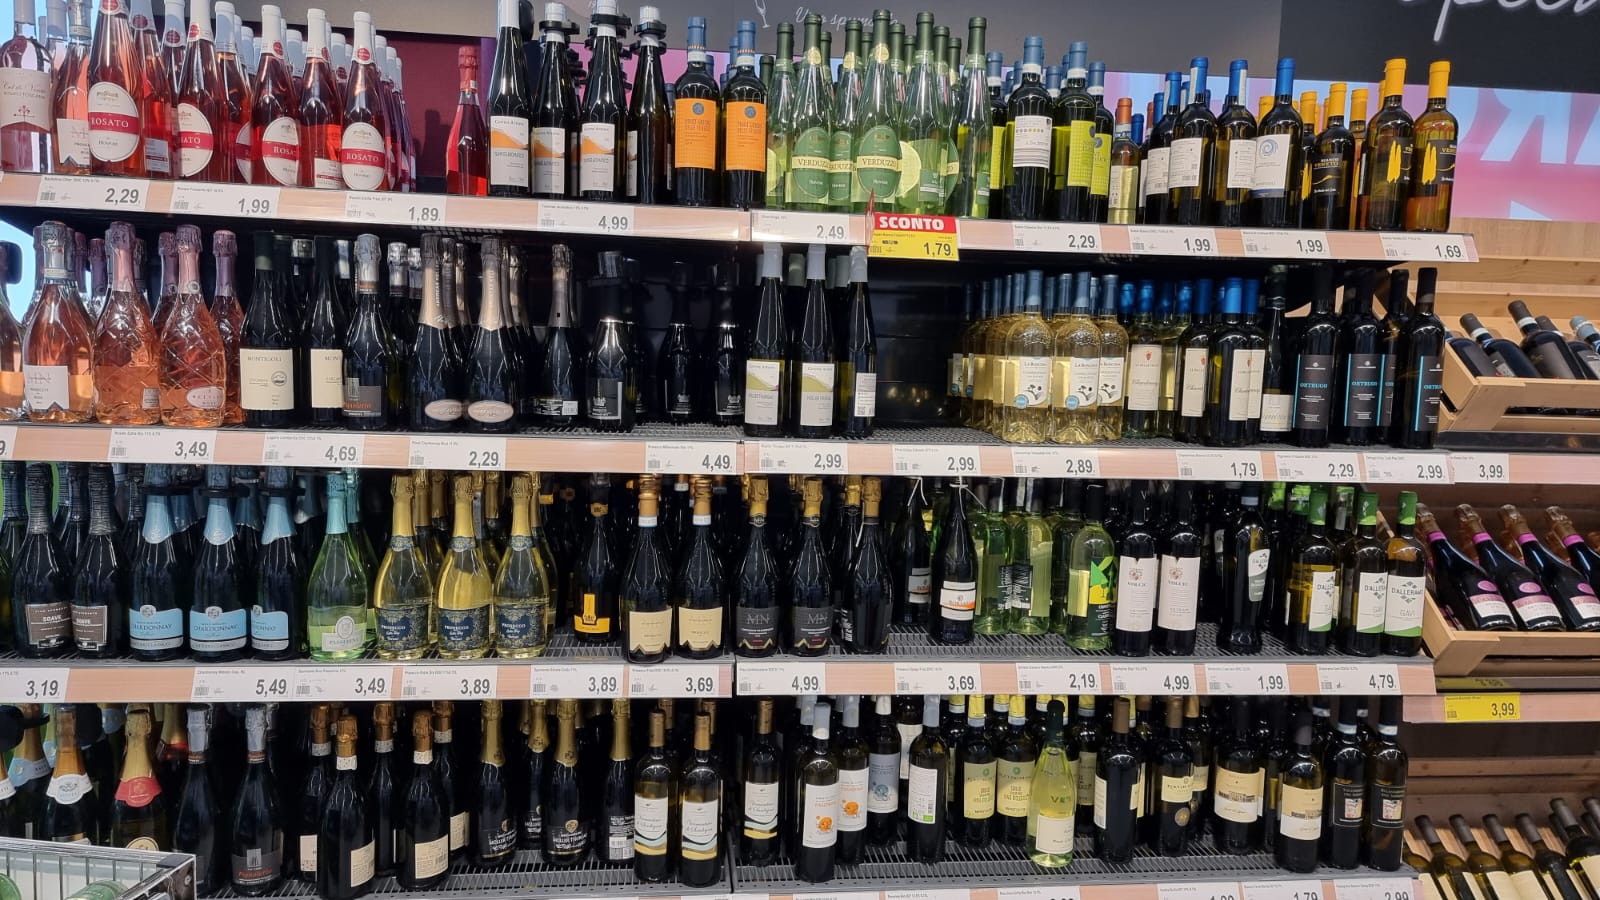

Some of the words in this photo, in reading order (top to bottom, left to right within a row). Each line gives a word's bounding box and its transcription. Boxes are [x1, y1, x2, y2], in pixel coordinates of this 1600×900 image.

[346, 152, 379, 163] ROSATO
[105, 188, 139, 204] 2,29
[238, 199, 269, 213] 1,99
[408, 207, 439, 222] 1,89
[598, 216, 628, 231] 4,99
[879, 216, 945, 231] SCONTO
[1069, 234, 1095, 250] 2,29
[1185, 238, 1210, 253] 1,99
[1297, 239, 1322, 255] 1,99
[924, 242, 951, 258] 1,79
[1435, 244, 1461, 259] 1,69
[175, 441, 207, 459] 3,49
[325, 446, 356, 463] 4,69
[469, 451, 498, 468] 2,29
[702, 455, 730, 472] 4,49
[815, 454, 841, 470] 2,99
[948, 457, 974, 472] 2,99
[1066, 460, 1092, 475] 2,89
[1231, 463, 1256, 478] 1,79
[1328, 464, 1353, 478] 2,29
[1417, 465, 1442, 479] 2,99
[1480, 465, 1502, 480] 3,99
[26, 680, 58, 699] 3,19
[256, 679, 286, 697] 5,49
[355, 678, 385, 696] 3,49
[461, 679, 489, 696] 3,89
[589, 677, 616, 694] 3,89
[686, 677, 713, 694] 3,69
[792, 676, 818, 693] 4,99
[949, 676, 974, 691] 3,69
[1069, 674, 1095, 690] 2,19
[1164, 676, 1189, 691] 4,99
[1258, 676, 1283, 691] 1,99
[1369, 675, 1393, 690] 4,79
[1492, 703, 1514, 717] 3,99
